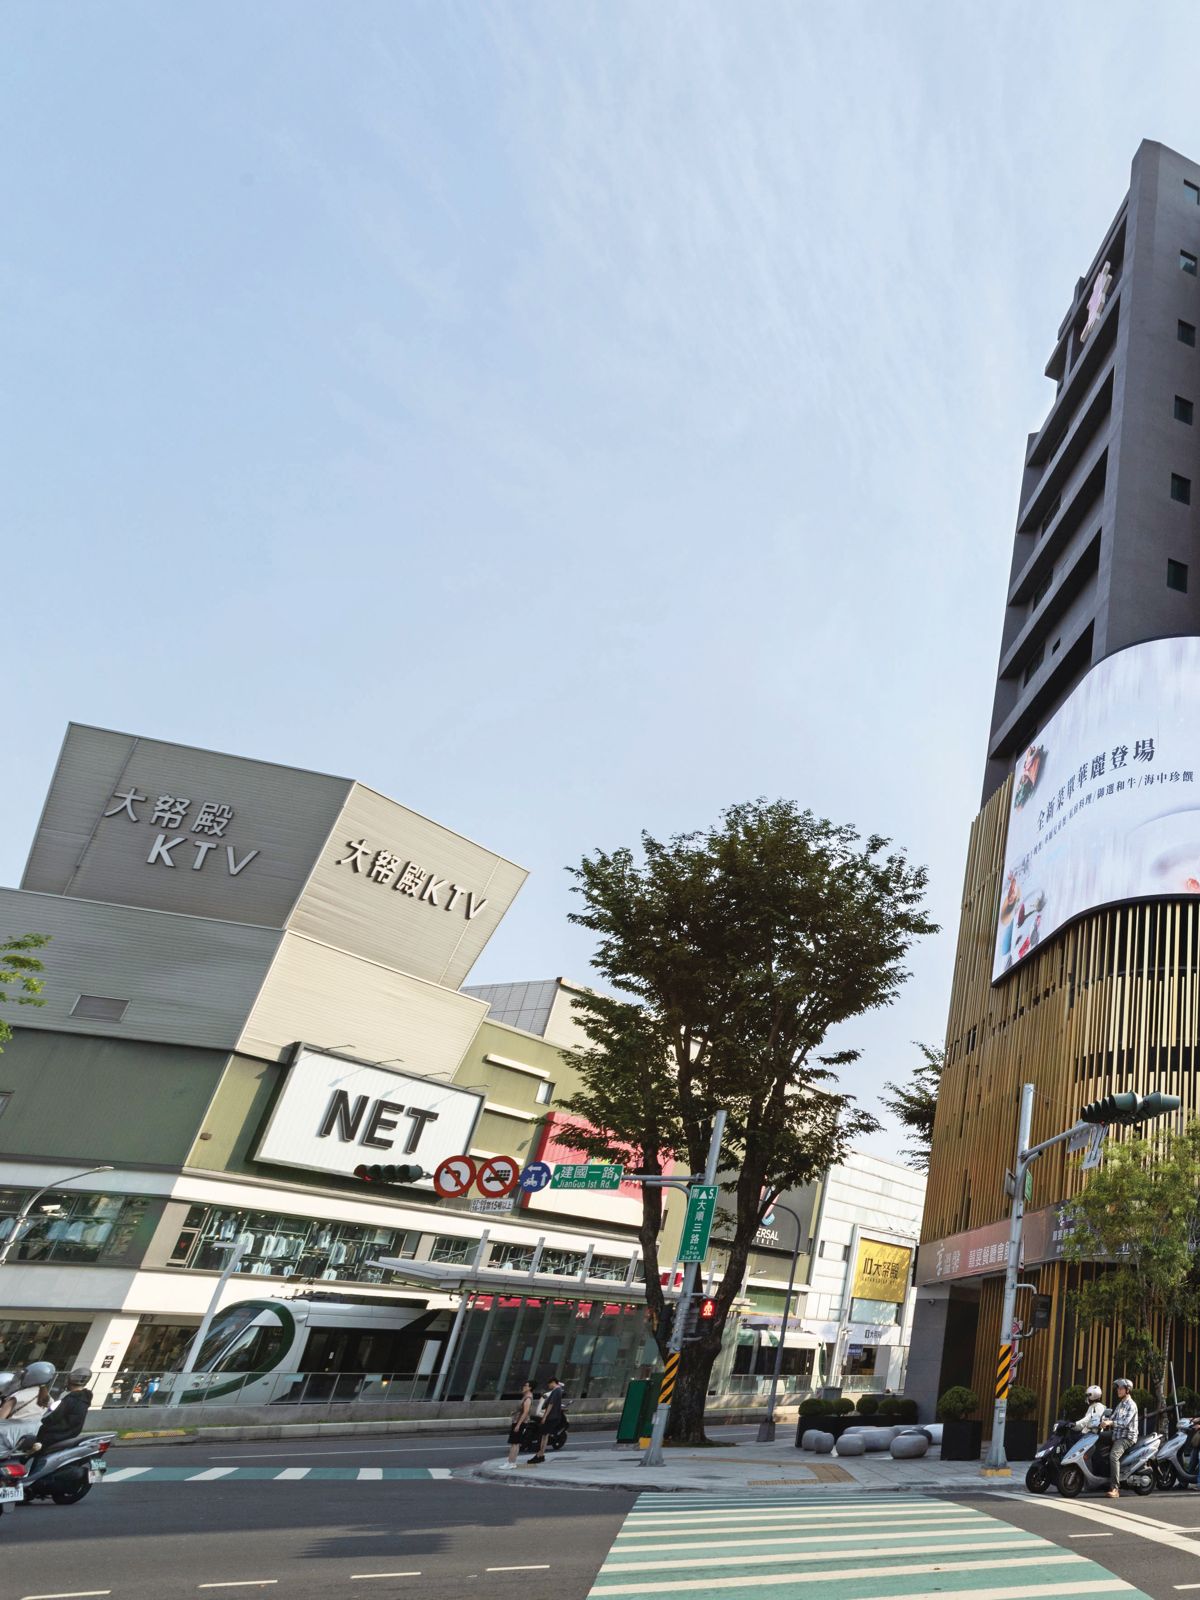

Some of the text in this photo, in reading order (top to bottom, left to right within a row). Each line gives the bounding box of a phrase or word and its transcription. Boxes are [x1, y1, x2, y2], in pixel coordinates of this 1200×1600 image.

[104, 787, 234, 838] 大帑殿
[146, 834, 260, 876] KTV
[319, 1089, 440, 1155] NET
[558, 1179, 585, 1189] JianGuo
[560, 1166, 615, 1179] 建國一路
[689, 1200, 707, 1244] 大順三路
